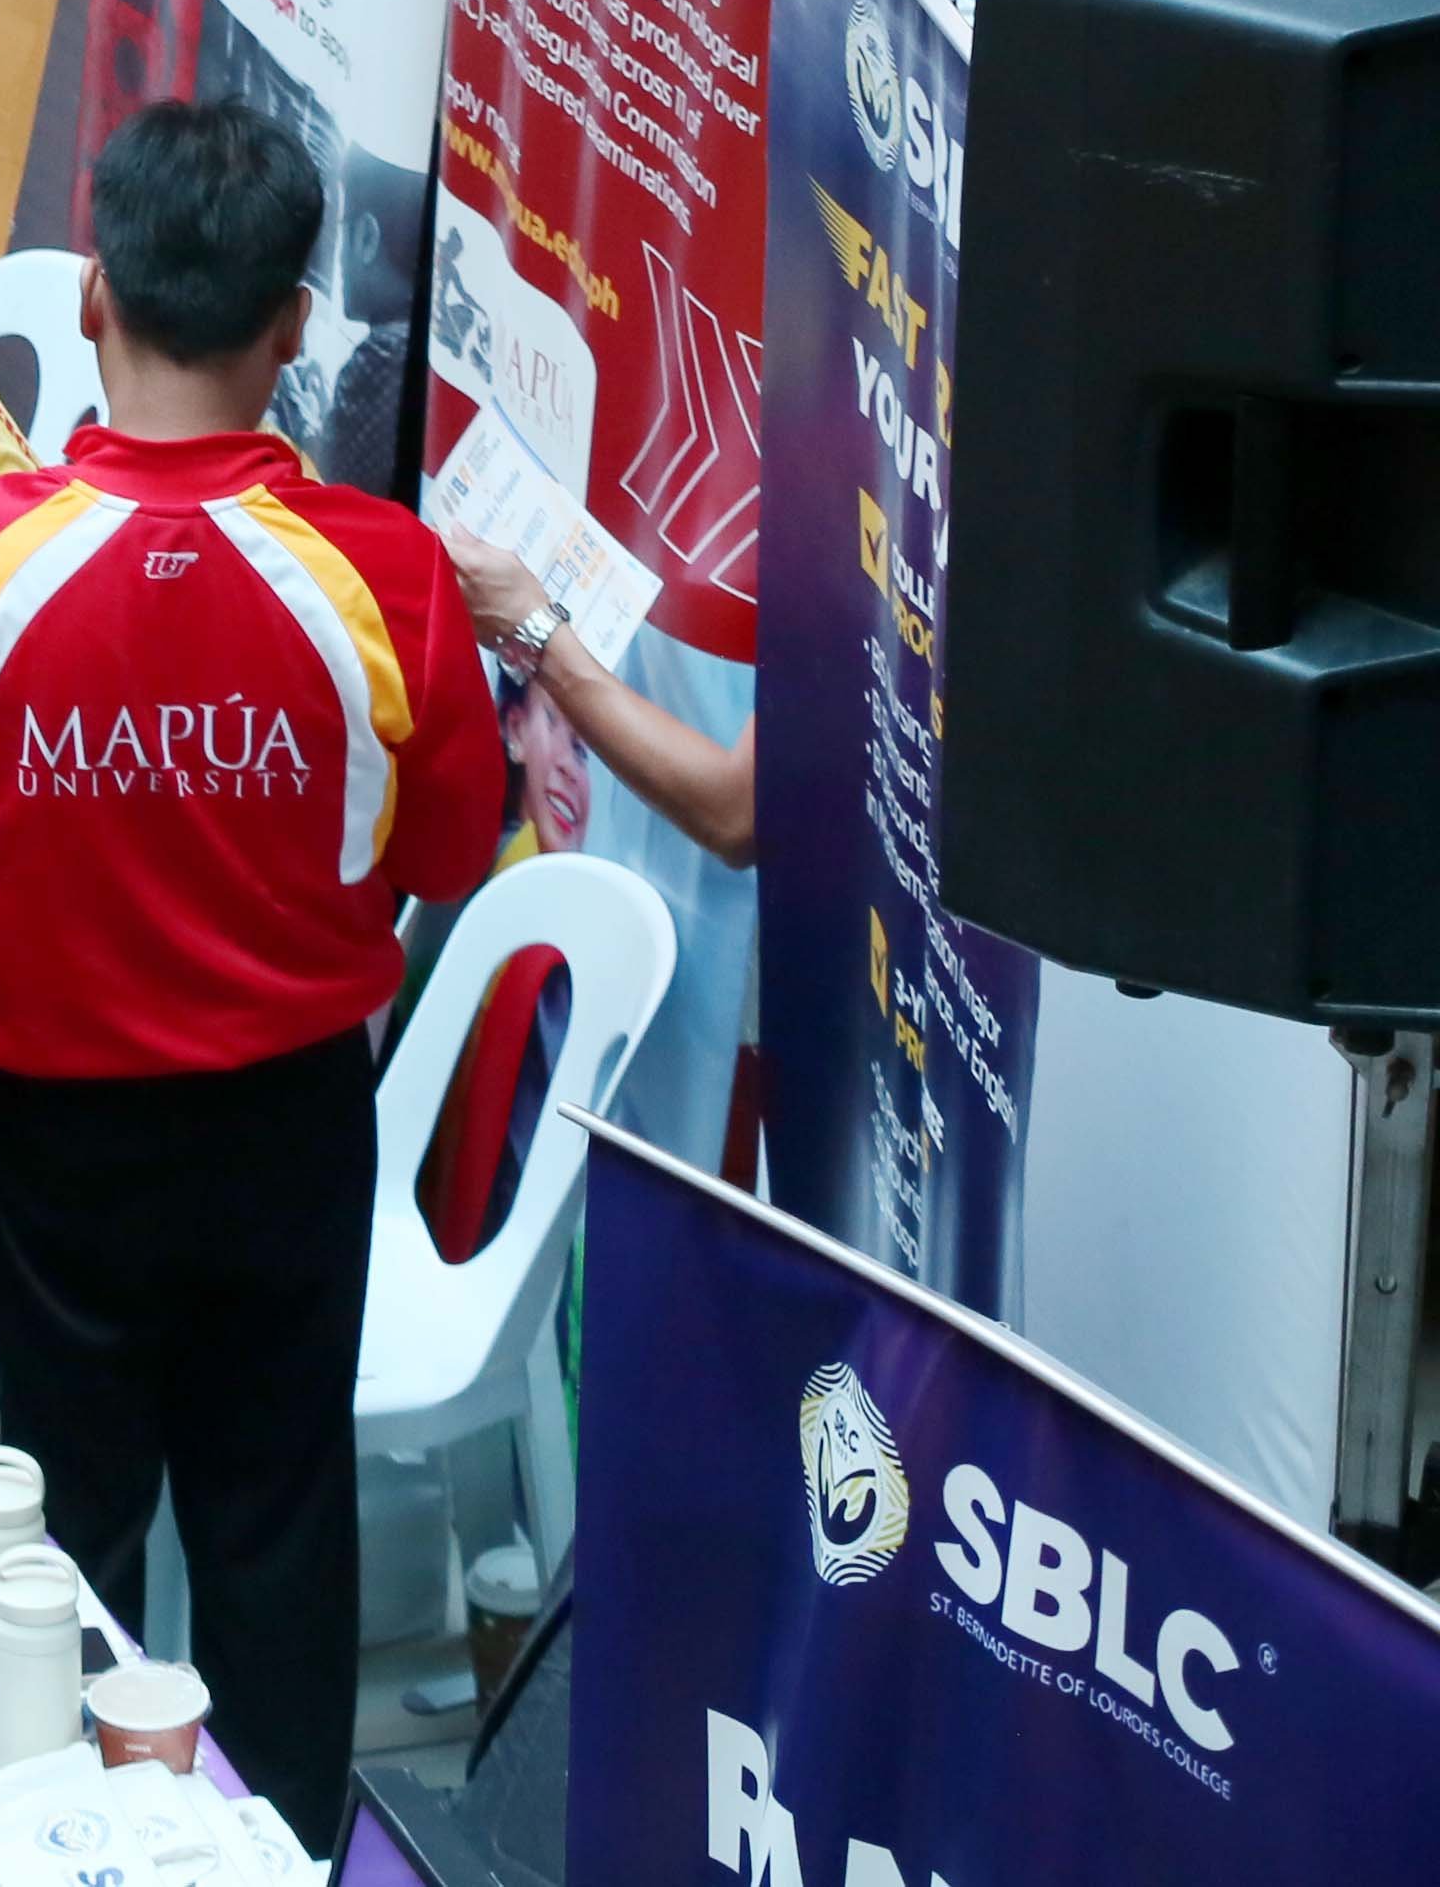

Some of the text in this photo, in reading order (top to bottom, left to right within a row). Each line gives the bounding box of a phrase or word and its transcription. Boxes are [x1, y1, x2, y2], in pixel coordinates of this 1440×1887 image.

[610, 44, 673, 108] across
[714, 87, 761, 138] over
[852, 335, 942, 513] YOUR
[18, 693, 306, 773] MAPÚA
[16, 768, 312, 798] UNIVERSITY
[934, 1464, 1241, 1752] SBLC
[930, 1591, 1231, 1802] ST. BERNADETTE OF LOURDES COLLEGE
